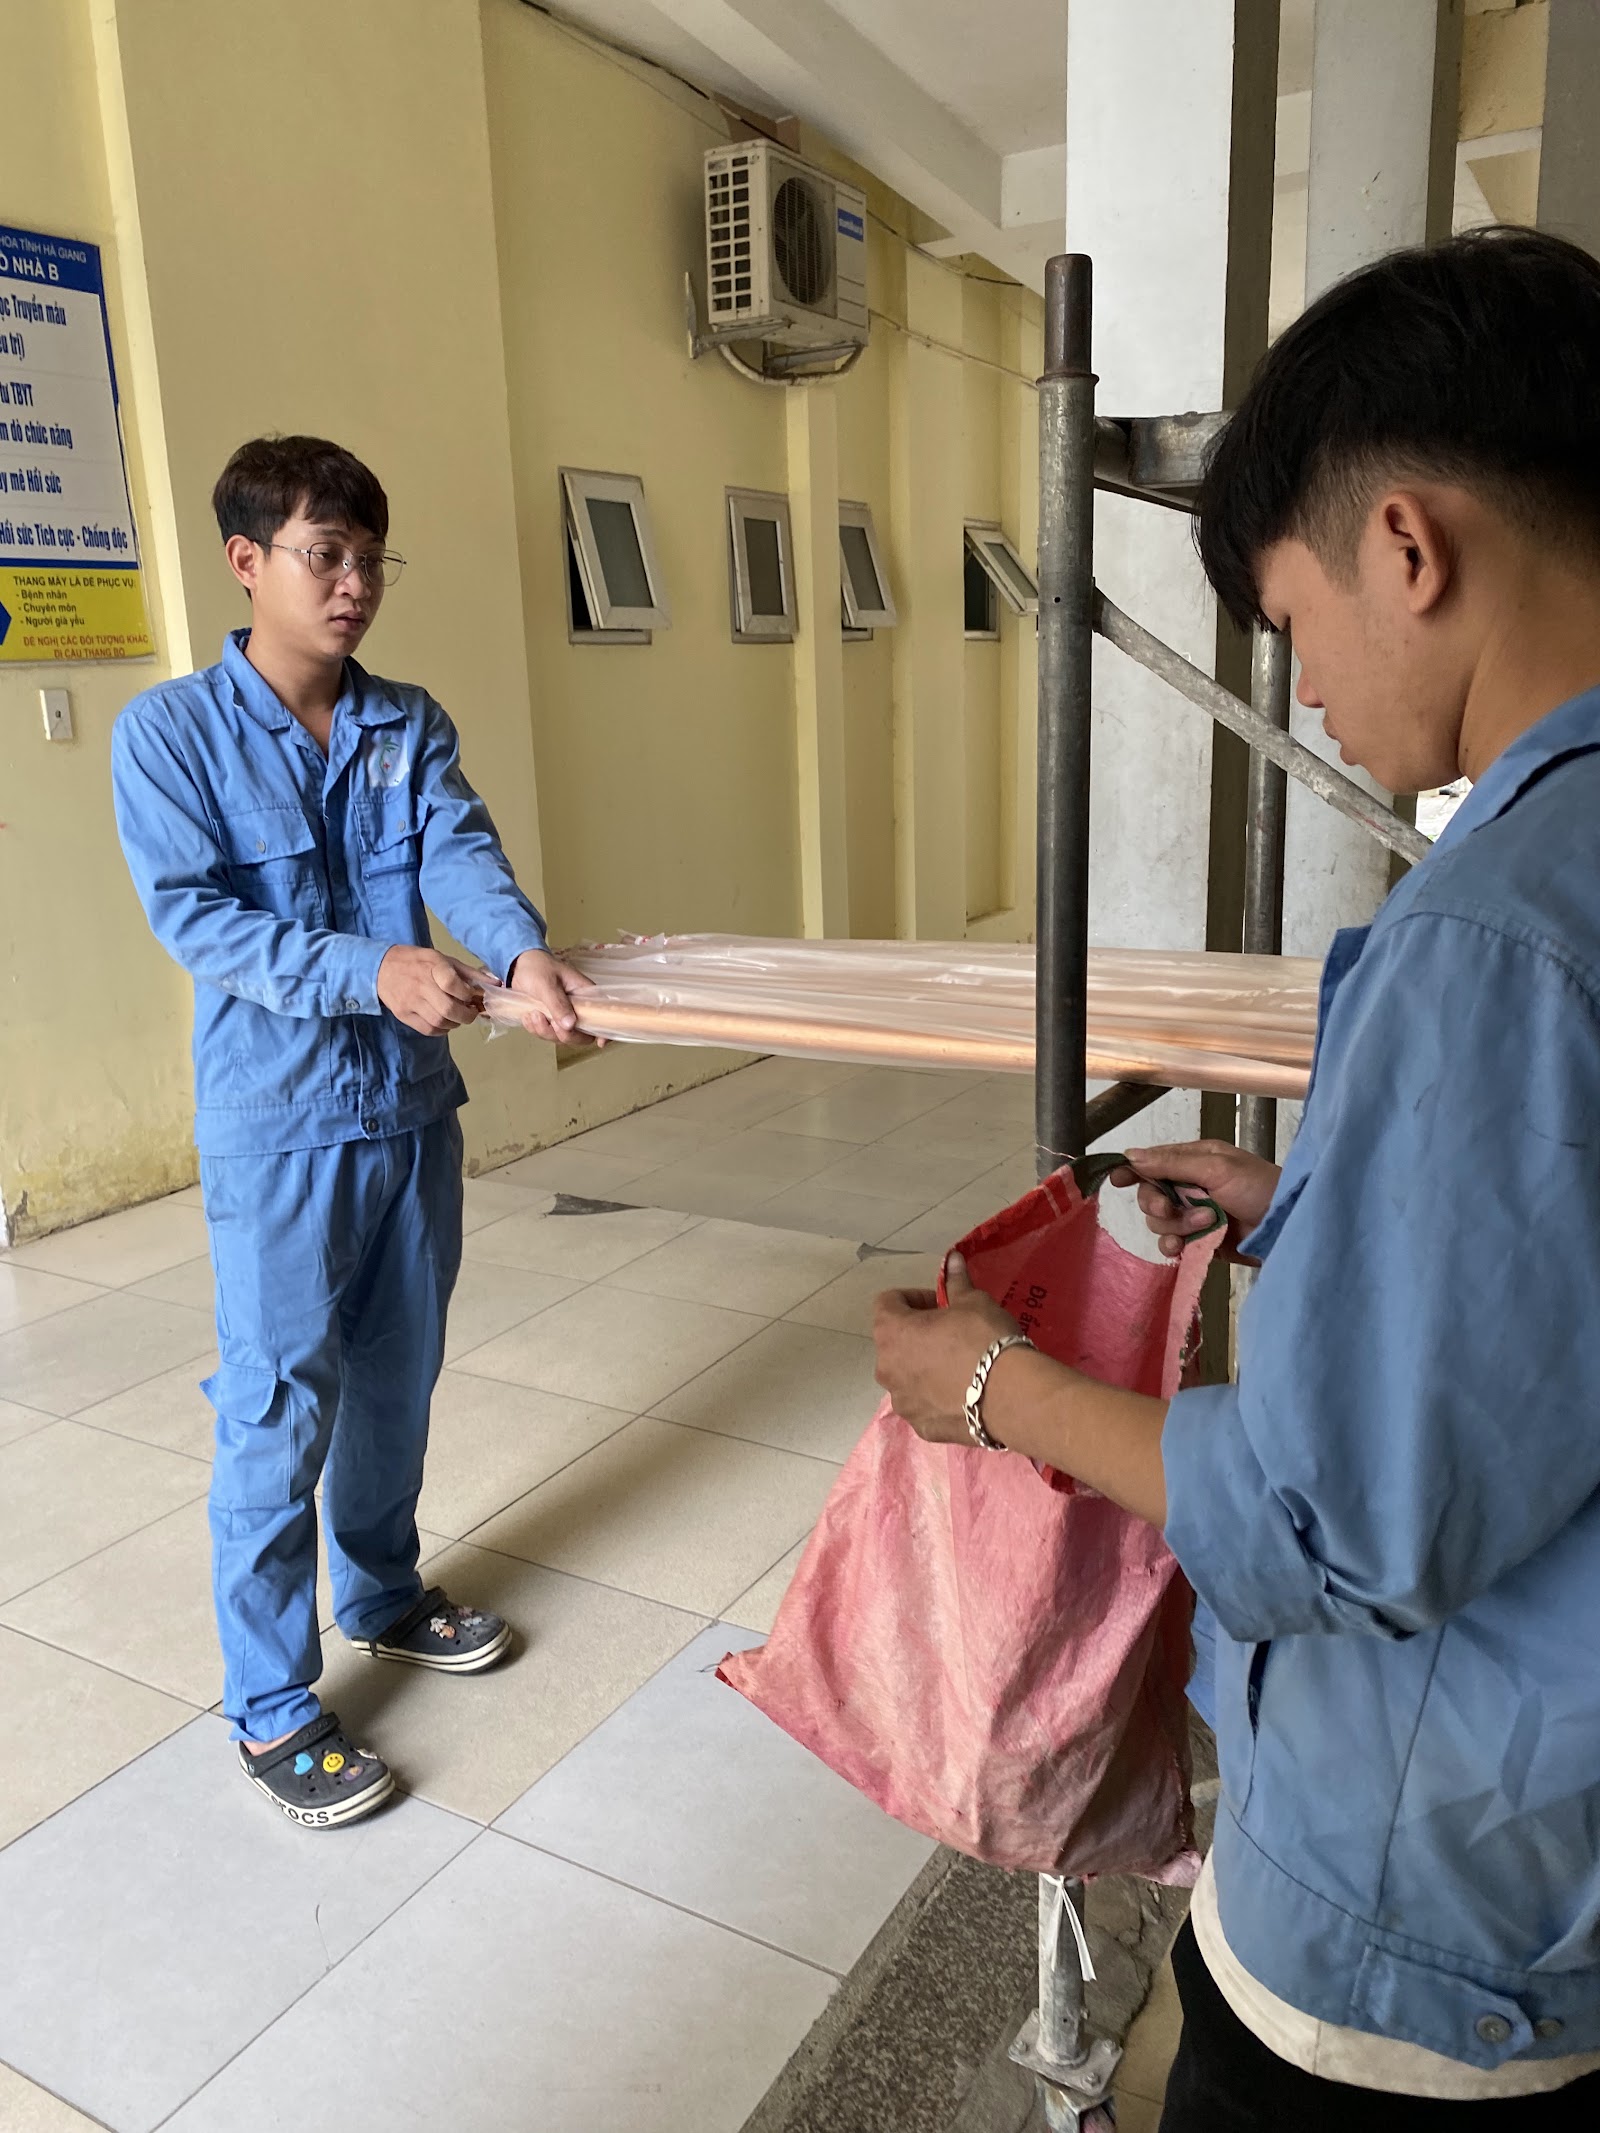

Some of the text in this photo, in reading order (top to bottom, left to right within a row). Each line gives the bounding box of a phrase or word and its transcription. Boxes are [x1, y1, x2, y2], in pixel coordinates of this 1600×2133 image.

[42, 243, 58, 259] HÀ
[57, 247, 87, 264] GIANG
[12, 255, 46, 280] NHÀ
[47, 262, 60, 281] B
[45, 301, 67, 326] máu
[10, 381, 34, 407] TBYT
[9, 468, 26, 492] mê
[44, 470, 62, 494] sức
[16, 522, 34, 546] sức
[57, 527, 75, 553] cực
[81, 523, 111, 551] Chống
[13, 575, 46, 587] THANG
[97, 577, 121, 589] PHỤC
[21, 589, 44, 601] Bệnh
[46, 589, 68, 600] nhân
[23, 602, 57, 615] Chuyên
[58, 602, 77, 613] môn
[25, 616, 53, 628] Người
